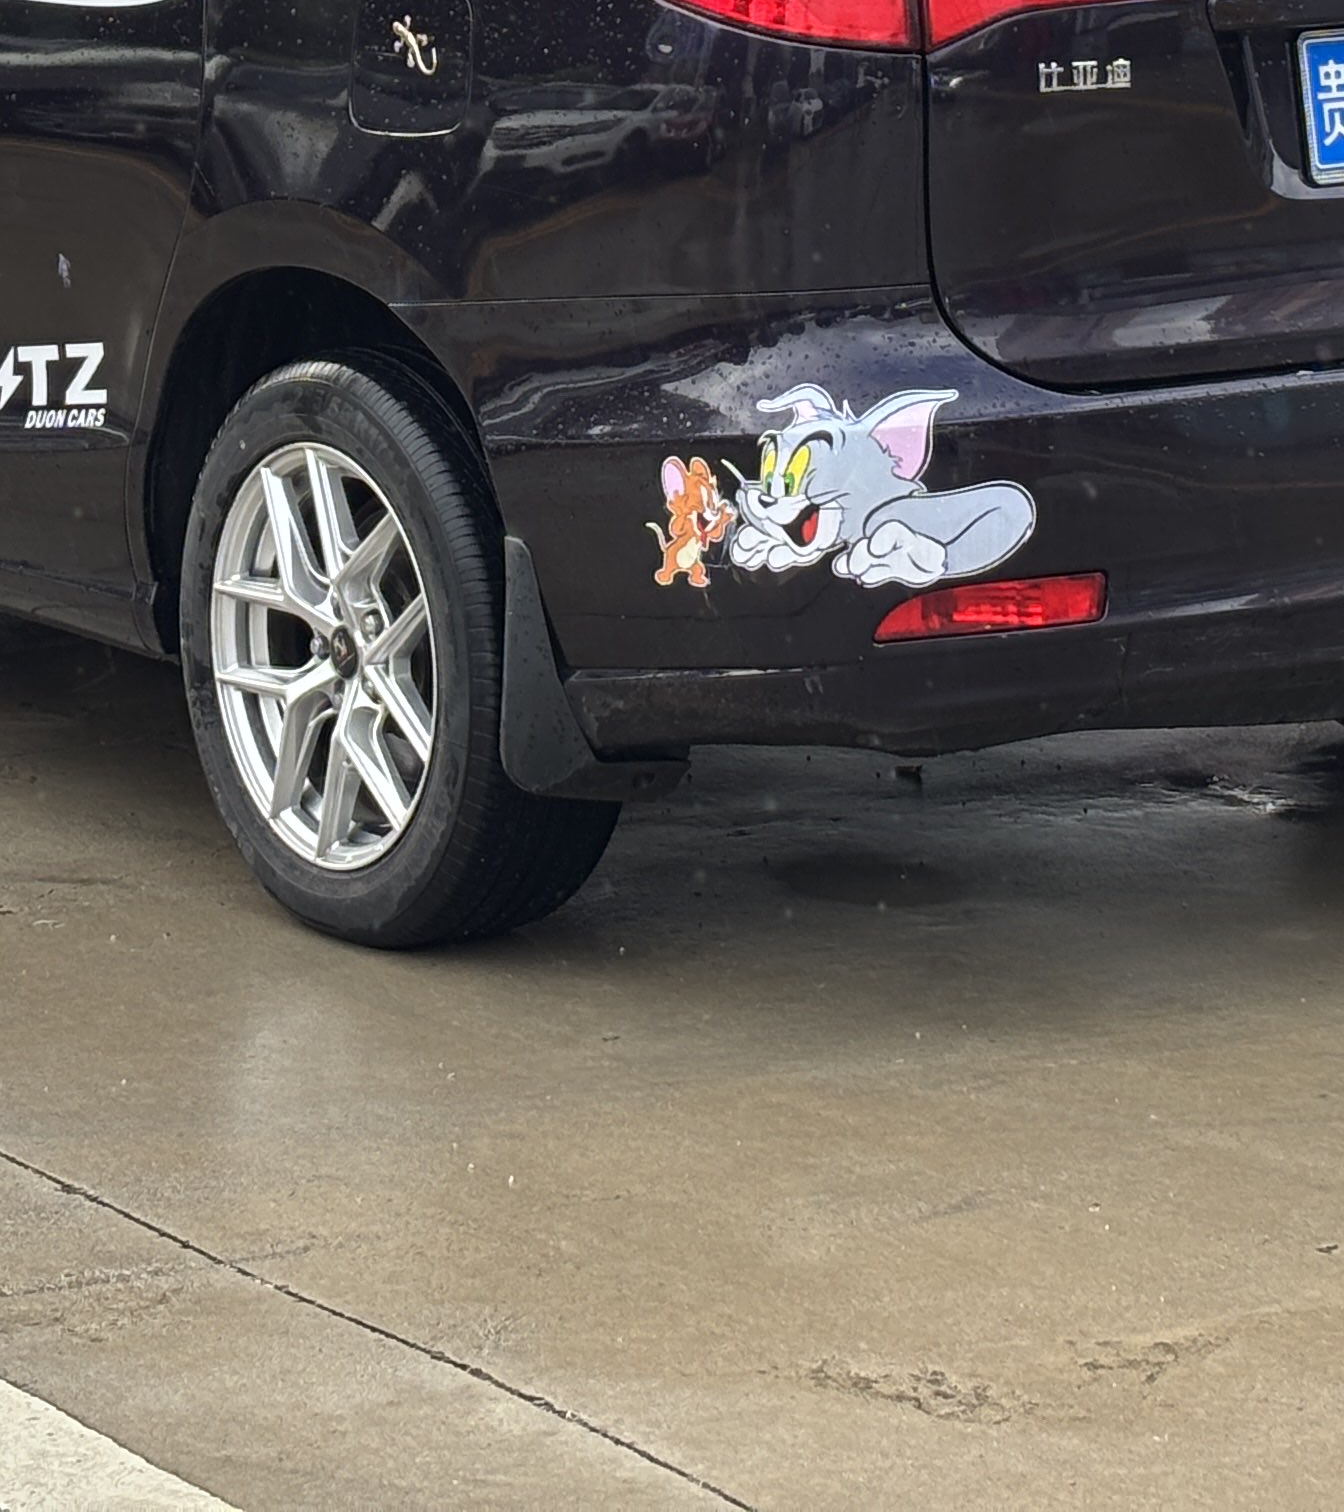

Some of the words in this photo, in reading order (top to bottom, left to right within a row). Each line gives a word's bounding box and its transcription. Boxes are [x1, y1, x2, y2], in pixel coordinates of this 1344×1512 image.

[1038, 57, 1132, 93] 比亚迪
[24, 409, 67, 429] DUON
[67, 408, 107, 428] CARS
